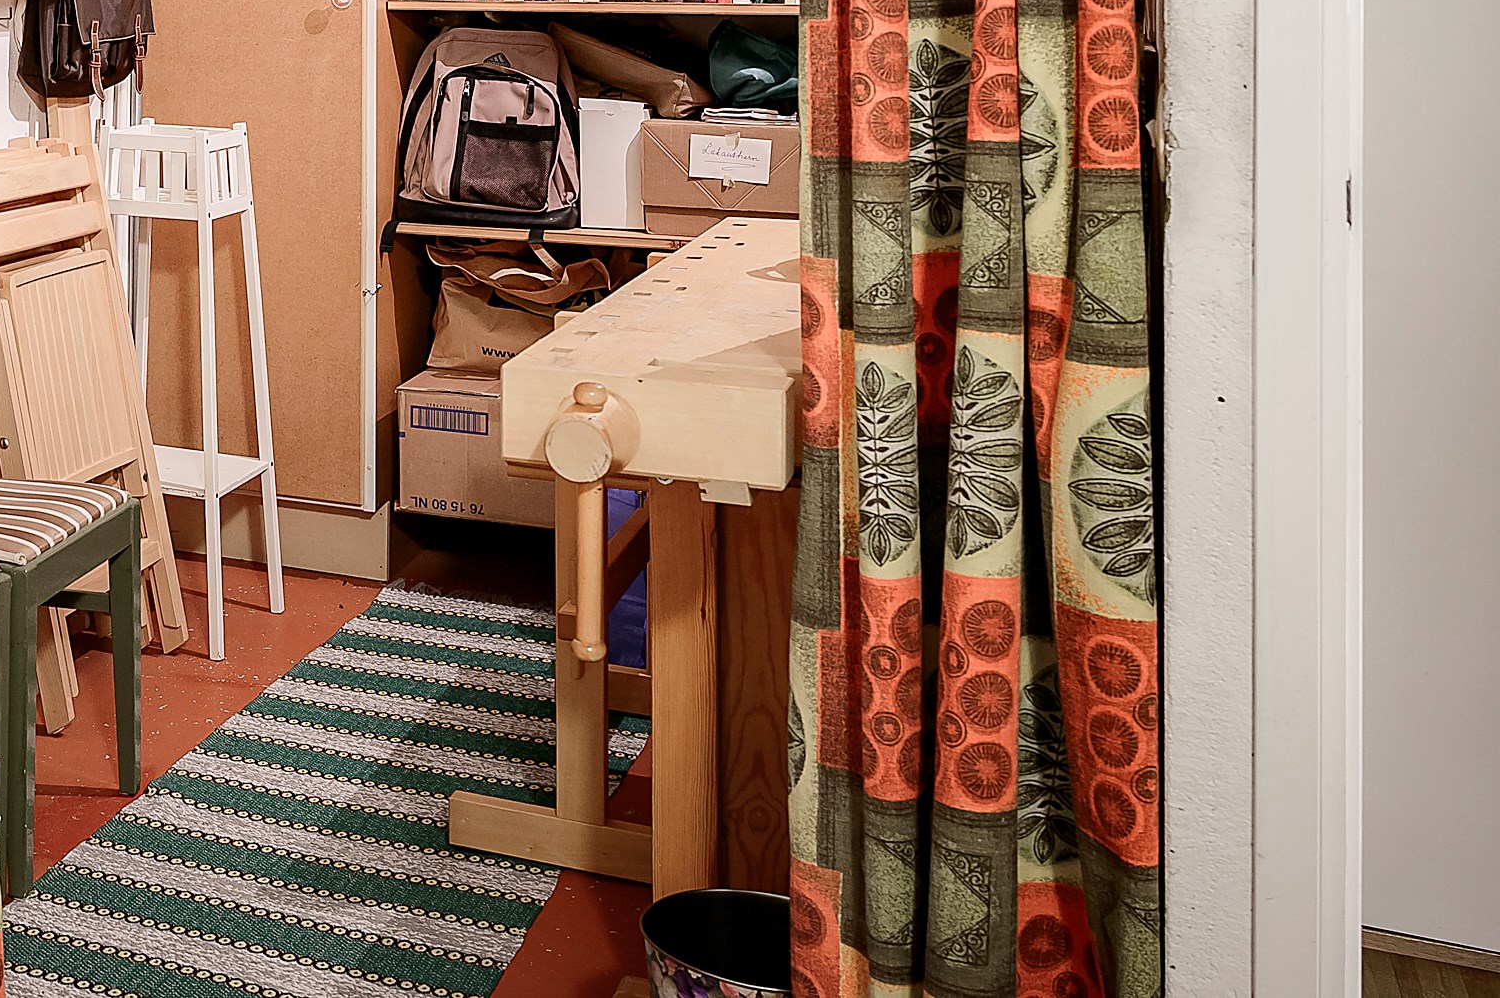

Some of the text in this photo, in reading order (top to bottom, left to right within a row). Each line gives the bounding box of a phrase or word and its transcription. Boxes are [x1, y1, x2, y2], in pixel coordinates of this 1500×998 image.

[410, 496, 485, 515] 76 15 80 NL
